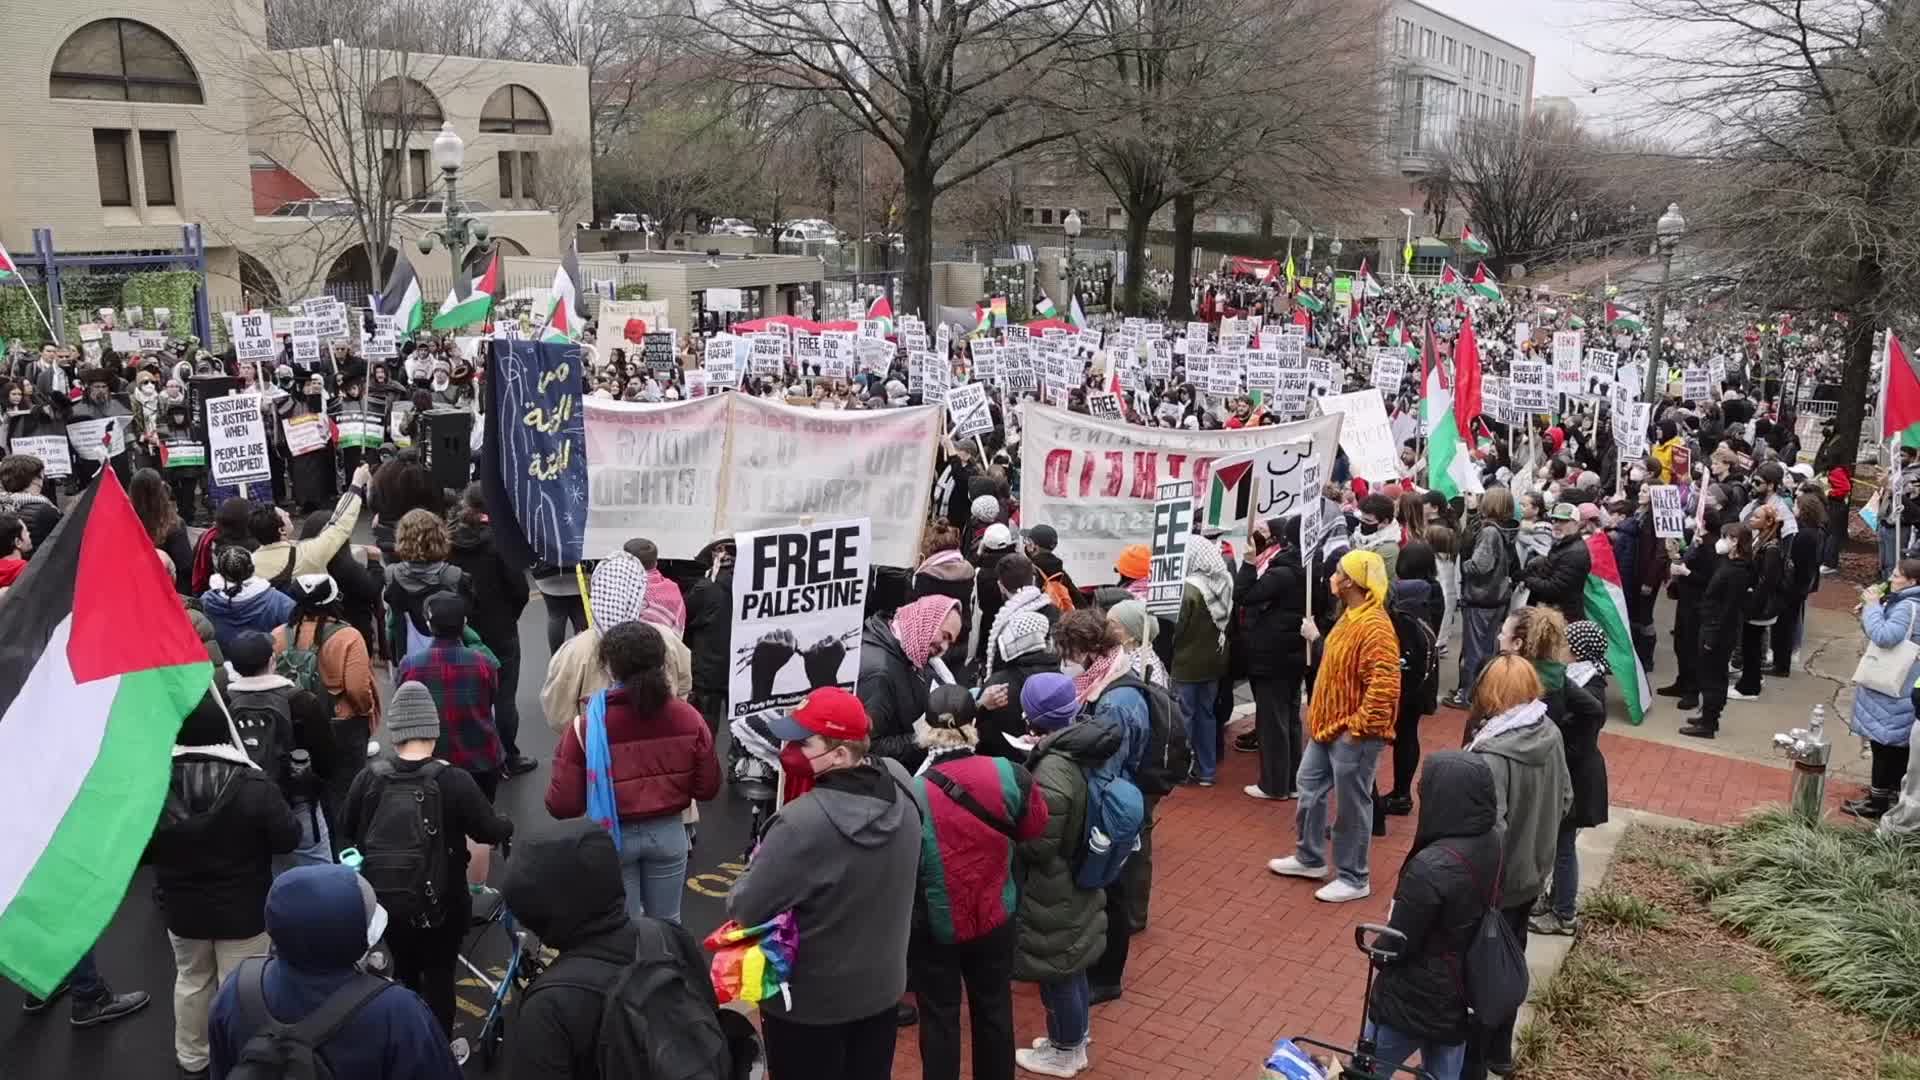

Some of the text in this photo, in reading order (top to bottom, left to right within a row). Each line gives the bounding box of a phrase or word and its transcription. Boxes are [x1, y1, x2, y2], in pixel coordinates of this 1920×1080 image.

[241, 315, 262, 327] END
[244, 326, 261, 337] ALL
[1008, 327, 1027, 337] FREE
[238, 339, 271, 350] U.S. AID
[754, 345, 781, 354] RAFAH!
[799, 337, 820, 350] FREE
[823, 339, 838, 349] END
[1154, 341, 1168, 349] END
[708, 348, 733, 359] RAFAH!
[824, 349, 838, 359] ALL
[1114, 351, 1128, 360] END
[1592, 351, 1614, 367] FREE
[1309, 359, 1330, 373] FREE
[1008, 376, 1034, 387] NOW!
[1512, 372, 1543, 384] RAFAH!
[1482, 385, 1497, 394] RAFA
[1515, 389, 1542, 397] STOP THE
[210, 397, 257, 414] RESISTANCE
[1091, 395, 1118, 413] FREE
[211, 410, 258, 427] IS JUSTIFIED
[1498, 407, 1523, 421] NOW!
[224, 424, 249, 438] WHEN
[214, 445, 246, 461] PEOPLE
[247, 443, 264, 456] ARE
[218, 457, 264, 474] OCCUPIED!
[1653, 496, 1680, 510] WALLS
[1152, 501, 1191, 556] EE
[1656, 516, 1682, 532] FALL
[752, 526, 860, 591] FREE
[741, 579, 864, 620] PALESTINE
